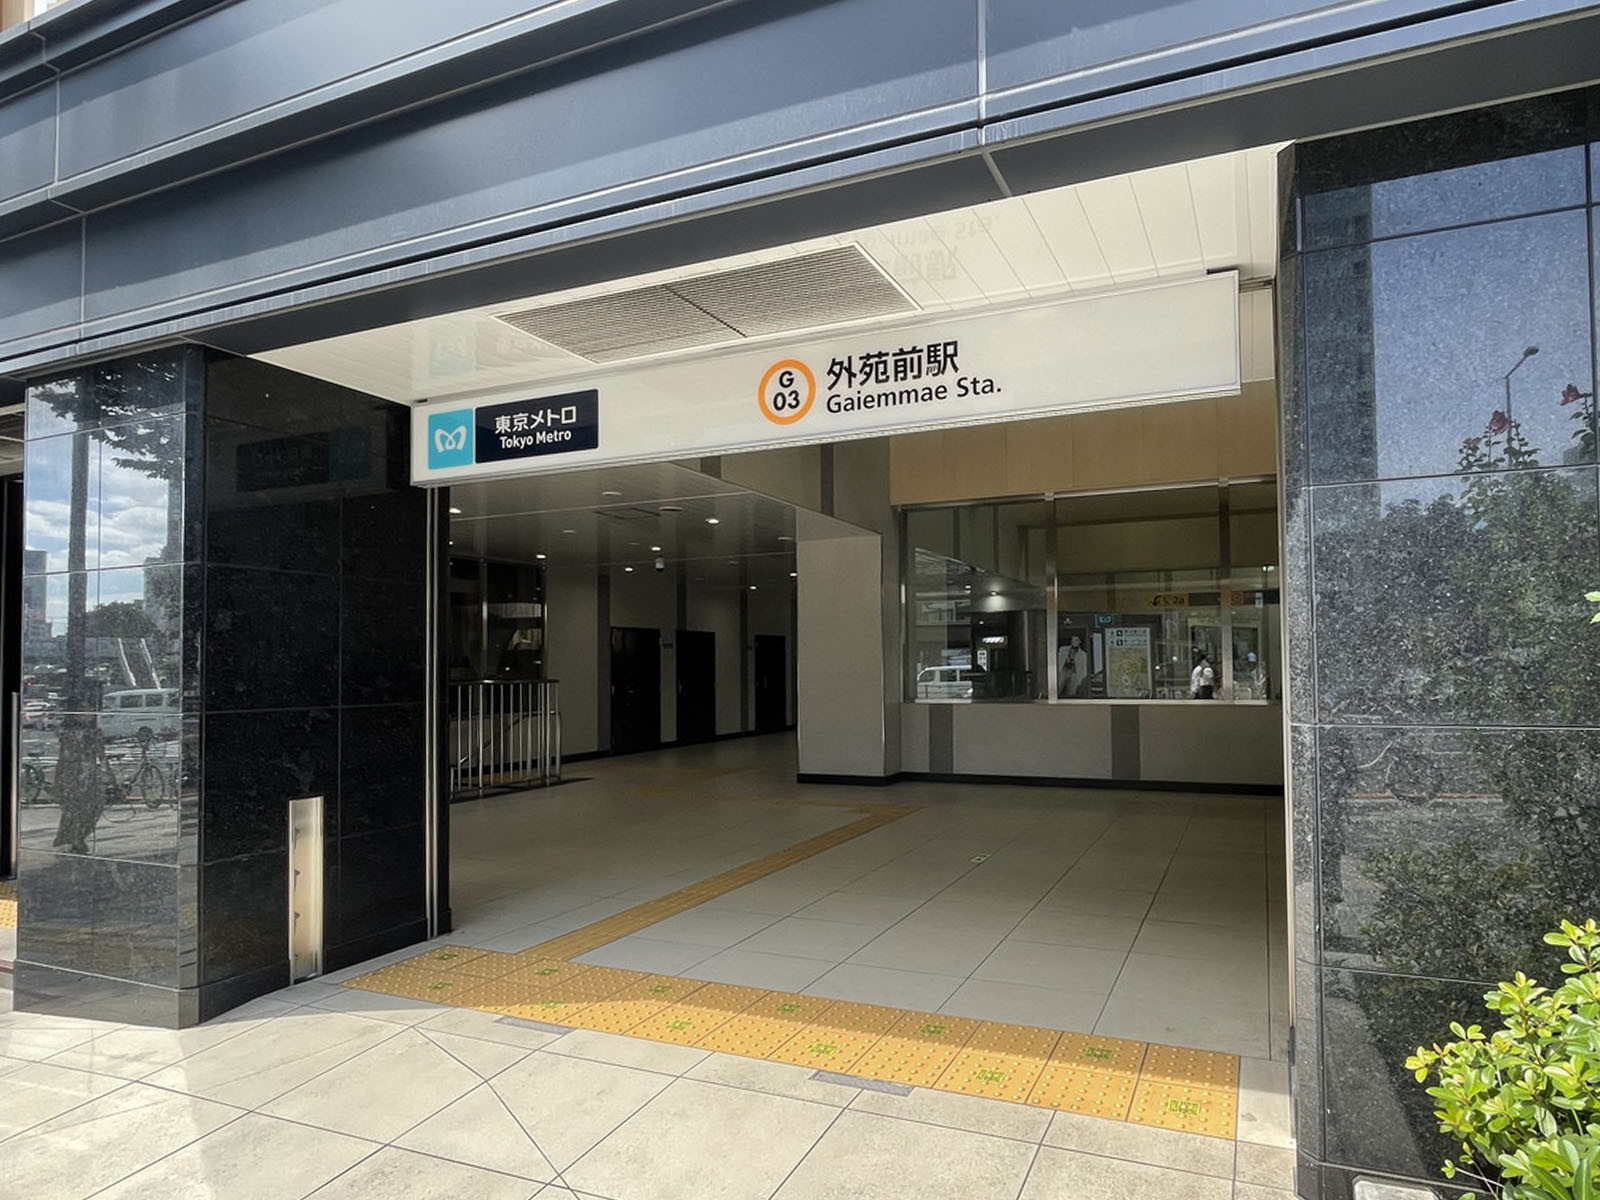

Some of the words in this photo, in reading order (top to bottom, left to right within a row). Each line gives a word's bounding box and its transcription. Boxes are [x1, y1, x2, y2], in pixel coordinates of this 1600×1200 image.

[827, 340, 959, 391] 外苑前駅
[779, 370, 794, 388] G
[773, 390, 800, 411] 03
[826, 384, 948, 413] Gaiemmae
[956, 377, 1002, 398] Sta.
[494, 405, 577, 434] 東京メトロ
[499, 434, 534, 449] Tokyo
[536, 430, 572, 444] Metro
